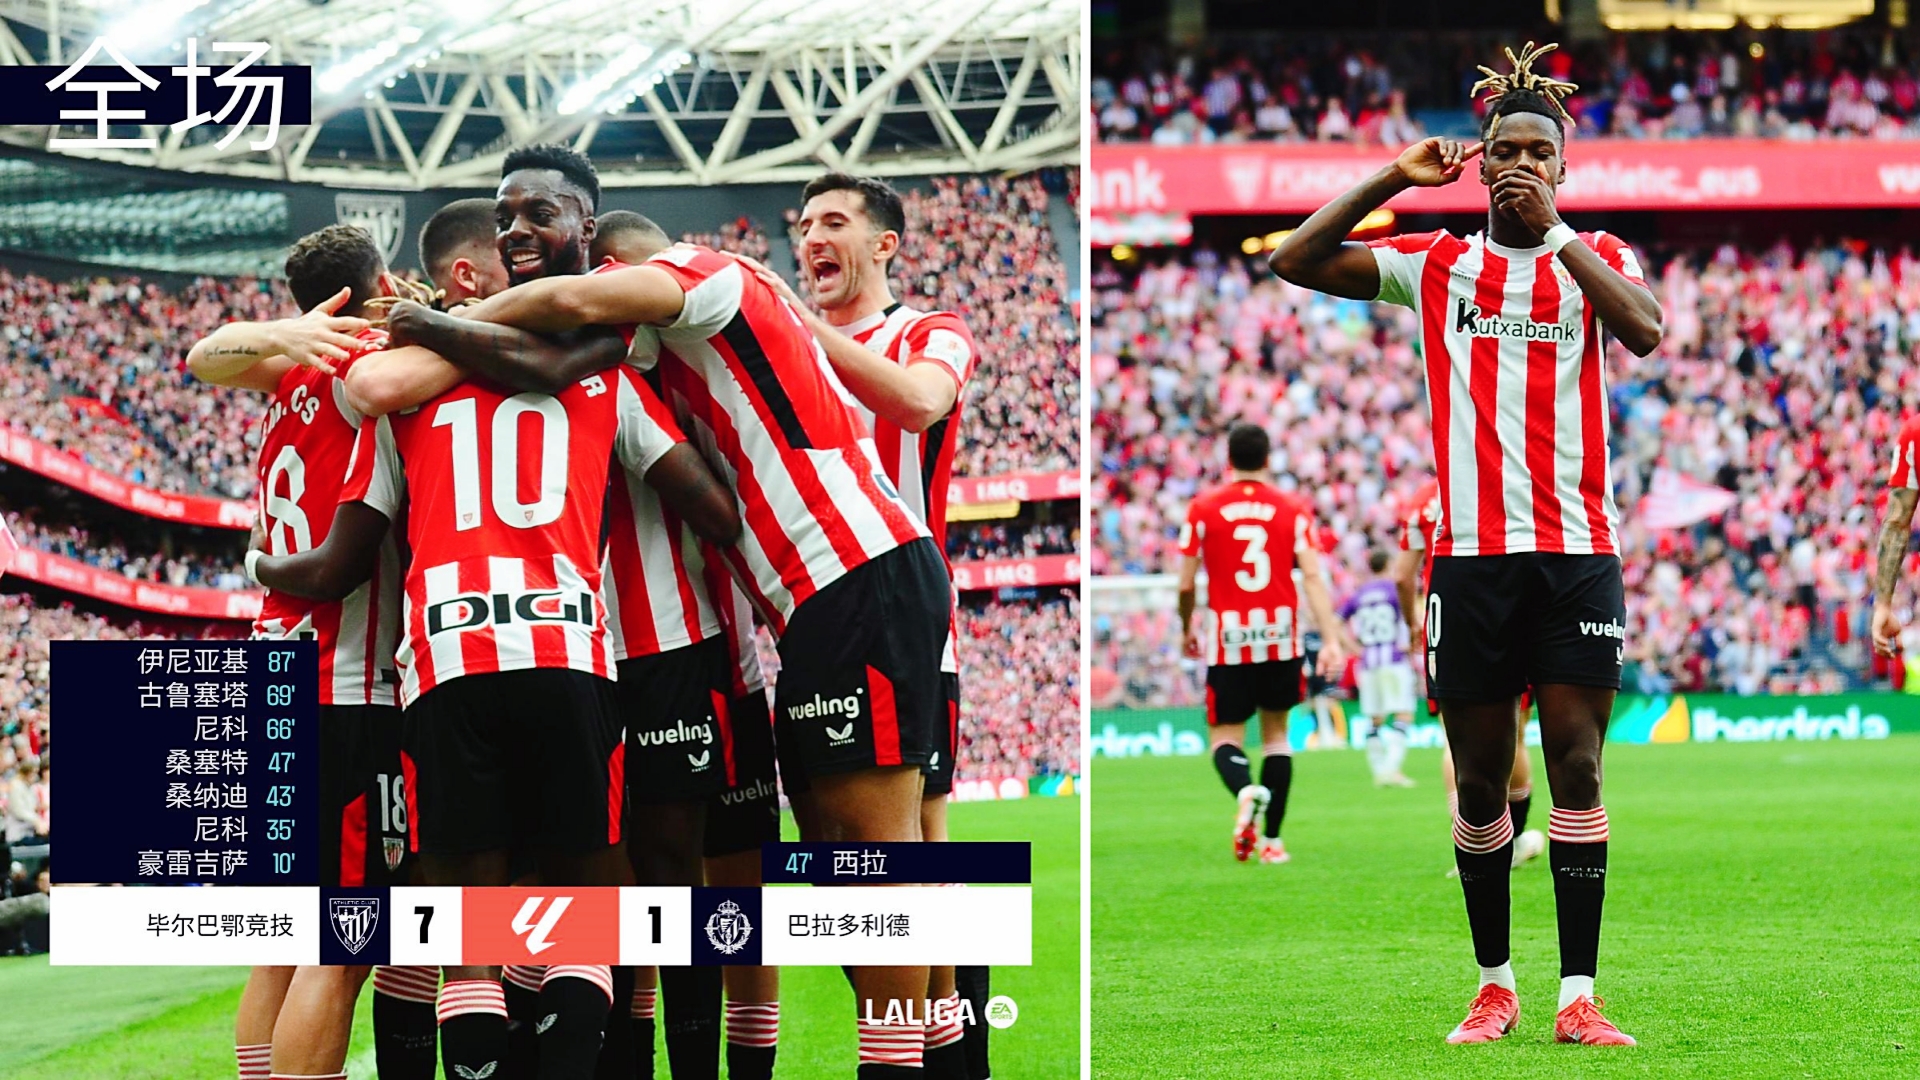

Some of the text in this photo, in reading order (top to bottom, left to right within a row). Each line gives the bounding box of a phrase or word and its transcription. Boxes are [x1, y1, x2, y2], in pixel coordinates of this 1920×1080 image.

[431, 391, 570, 532] 10
[1233, 524, 1272, 593] 3
[428, 591, 594, 638] DIGI
[638, 715, 714, 746] vueling
[788, 688, 864, 720] vueling
[377, 773, 407, 833] 18
